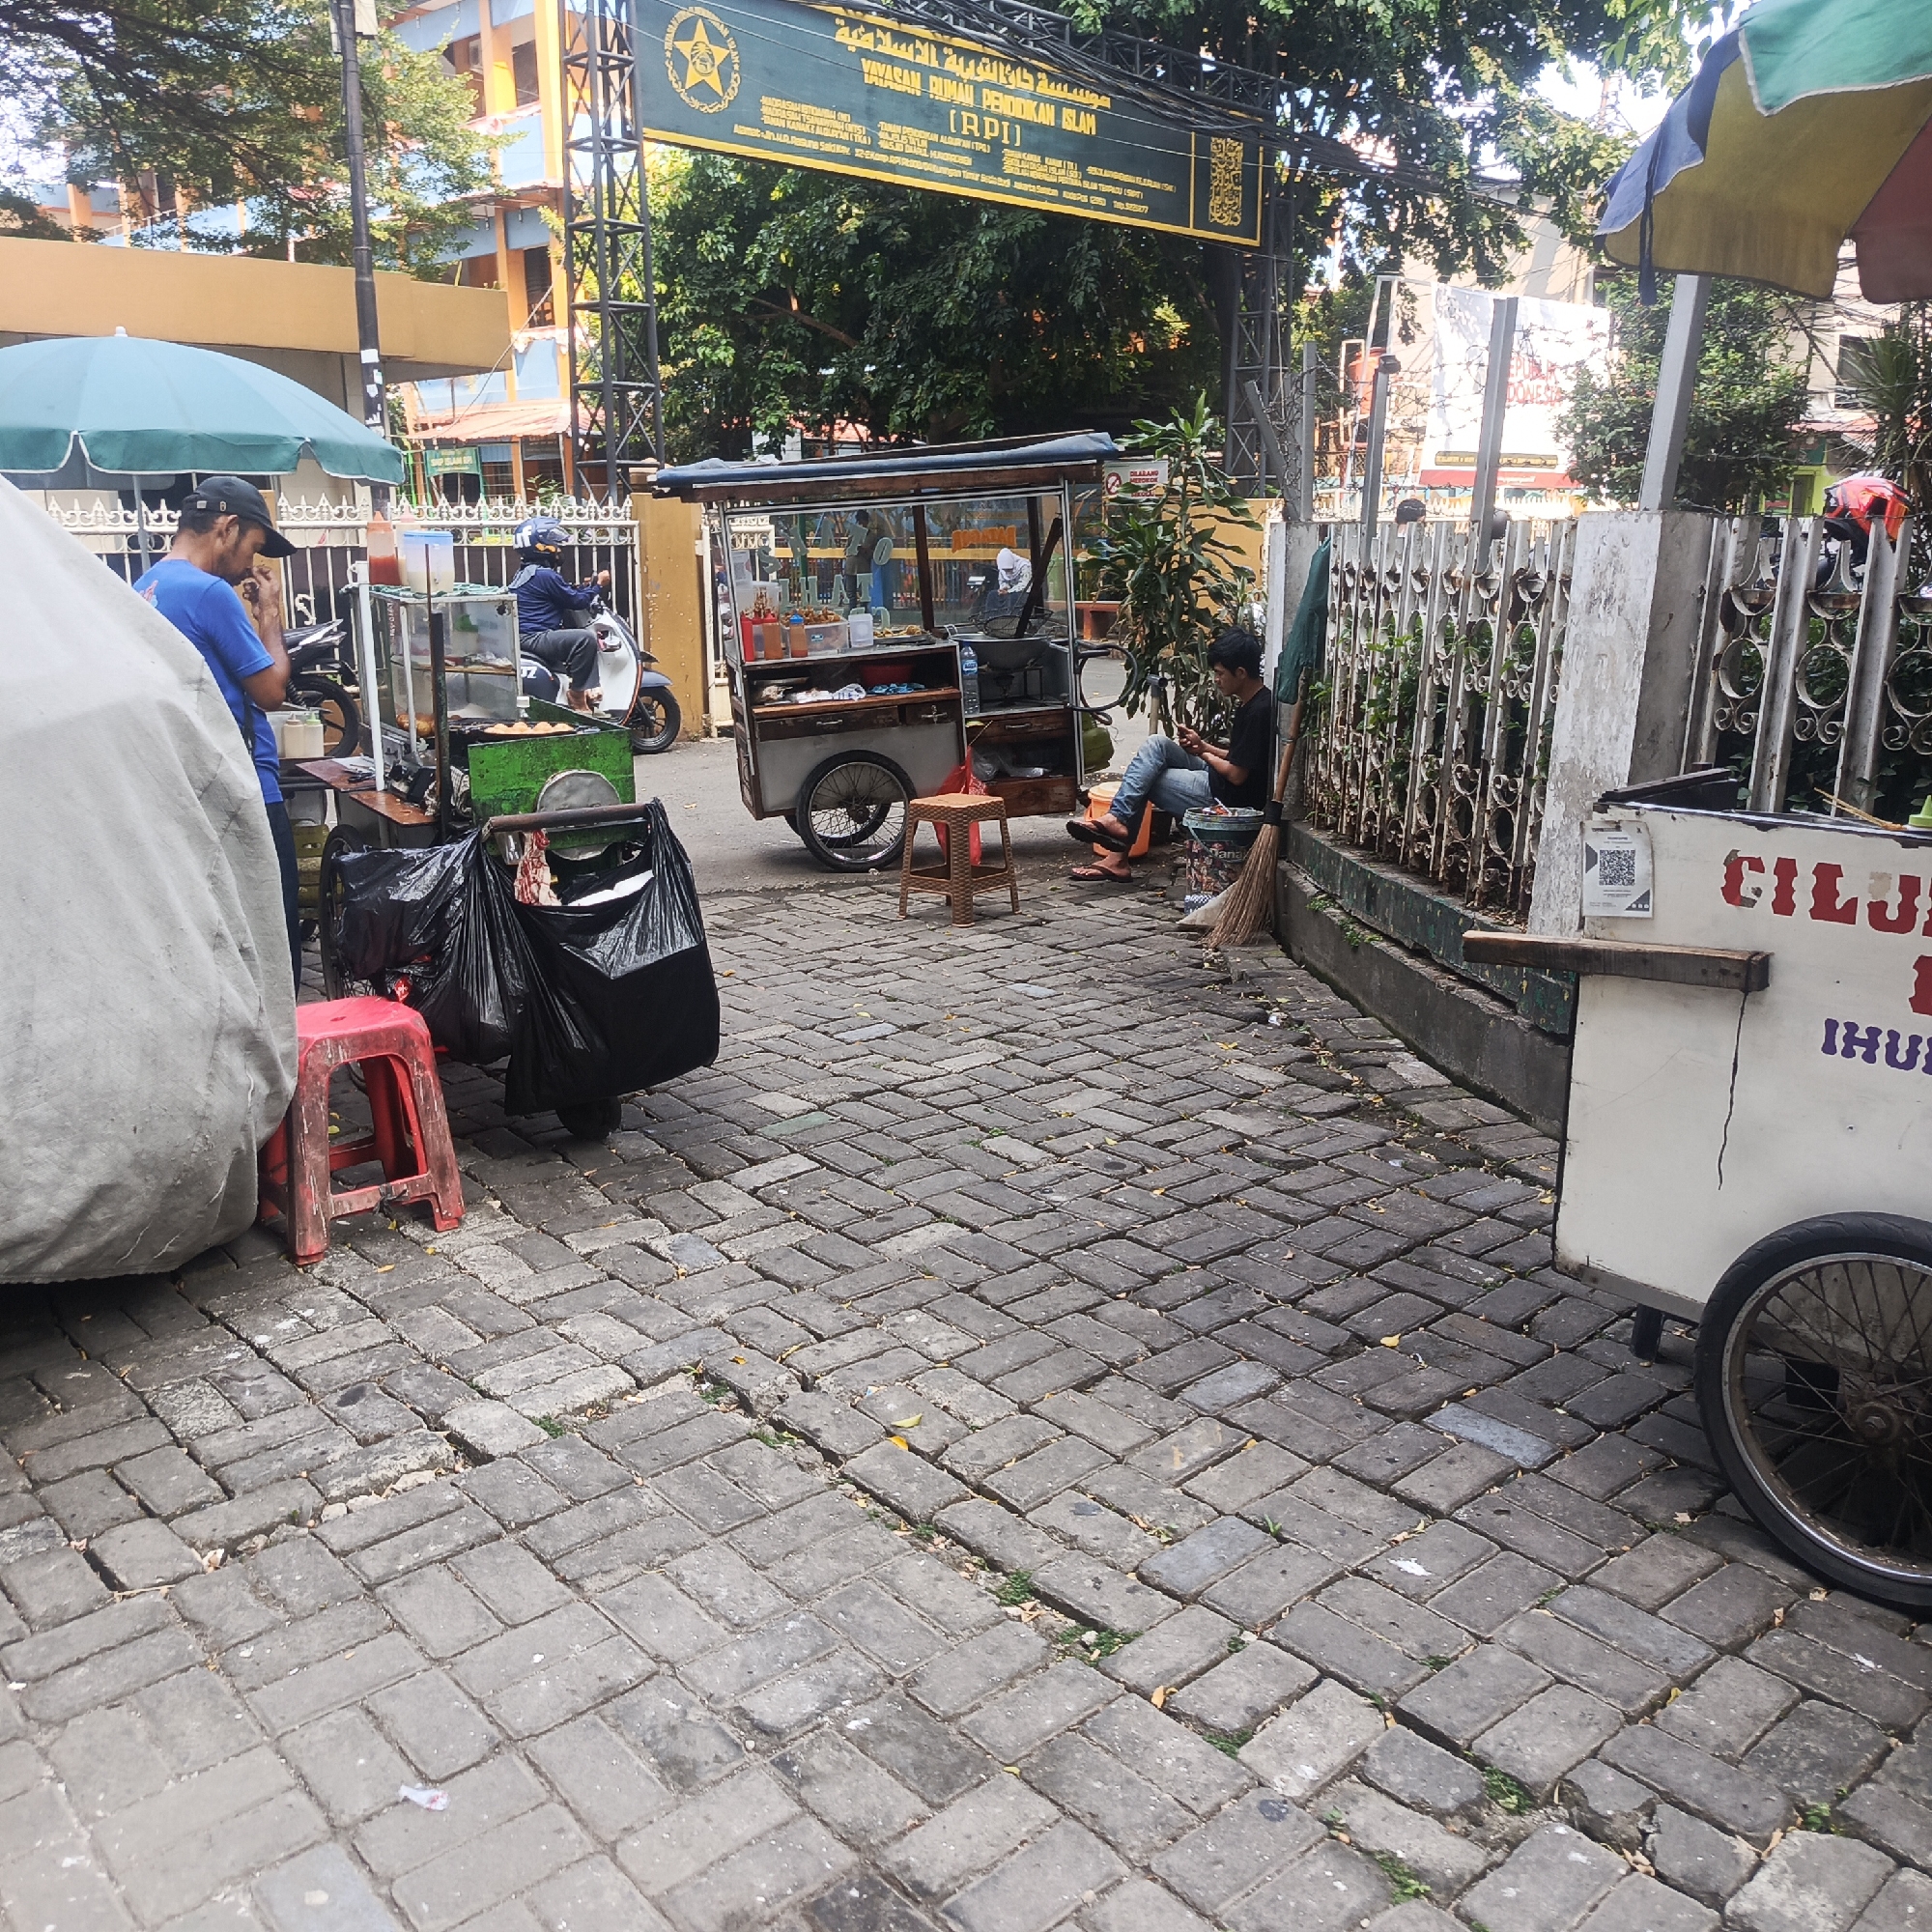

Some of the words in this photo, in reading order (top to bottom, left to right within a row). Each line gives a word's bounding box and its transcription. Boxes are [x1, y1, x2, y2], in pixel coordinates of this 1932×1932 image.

[861, 58, 921, 97] YAYASAN
[929, 75, 975, 107] RUMAH
[982, 89, 1056, 127] PENDIDIKAN
[1063, 106, 1096, 135] ISLAM
[1509, 355, 1557, 383] EPUBLIK
[1821, 1017, 1932, 1076] IHU
